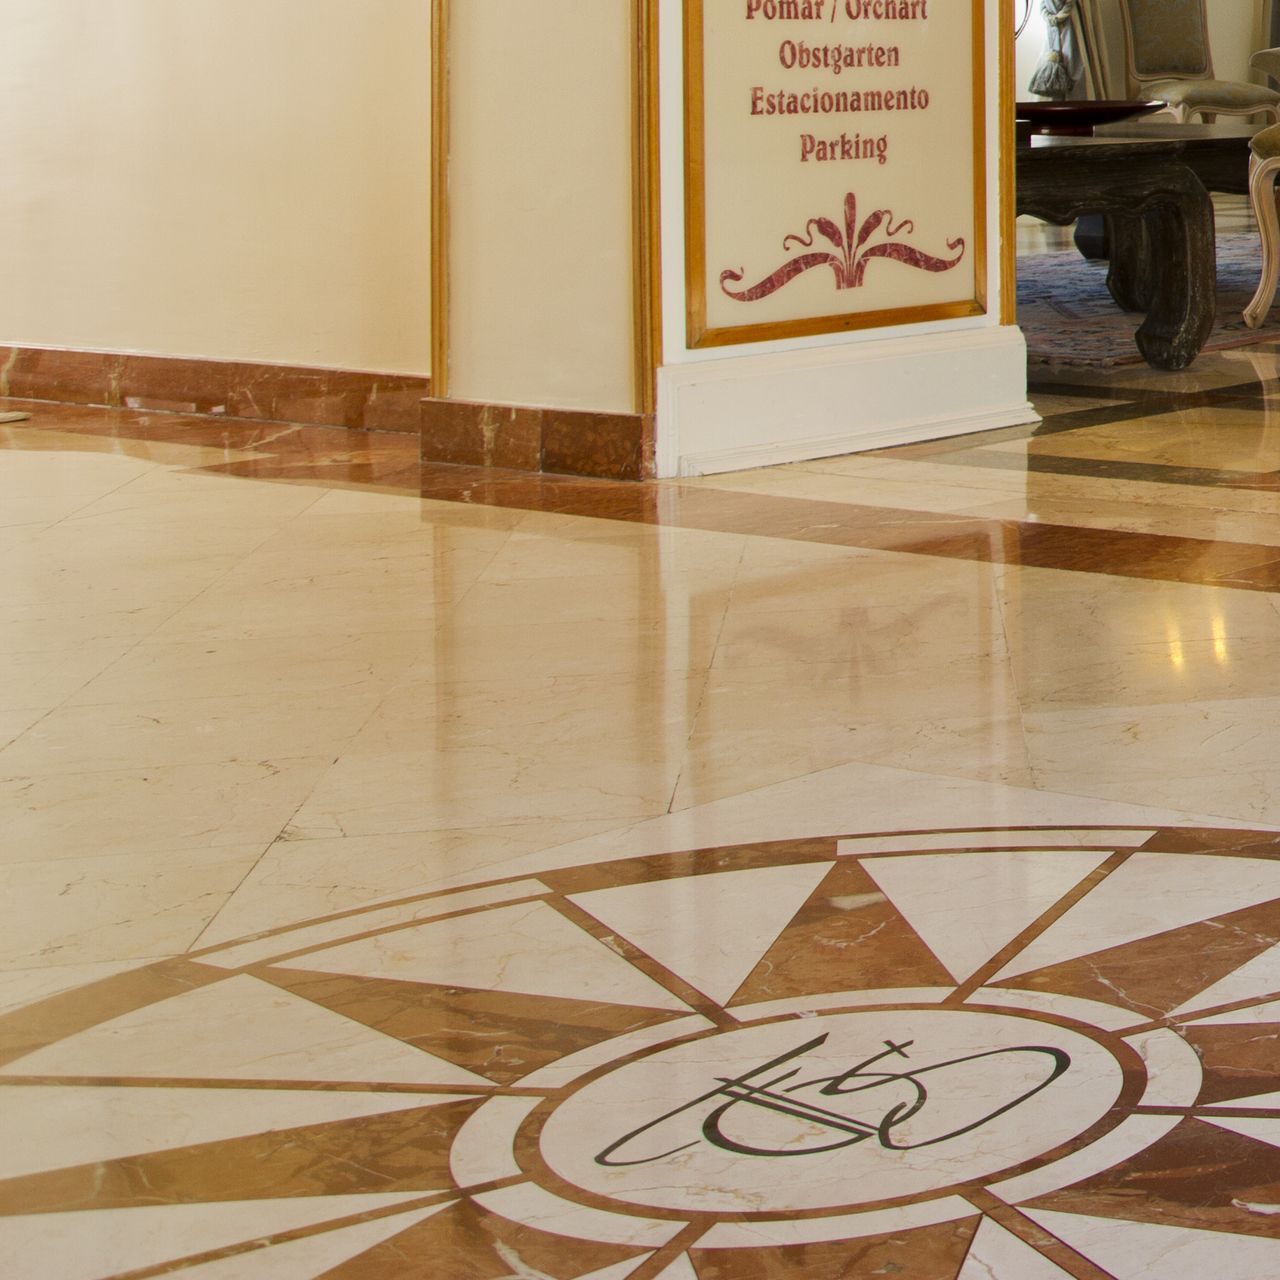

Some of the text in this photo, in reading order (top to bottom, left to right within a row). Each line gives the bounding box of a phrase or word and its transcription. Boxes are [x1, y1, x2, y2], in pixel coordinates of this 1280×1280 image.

[778, 39, 900, 75] Obstgarten
[750, 85, 930, 116] Estacionamento
[800, 133, 888, 165] Parking
